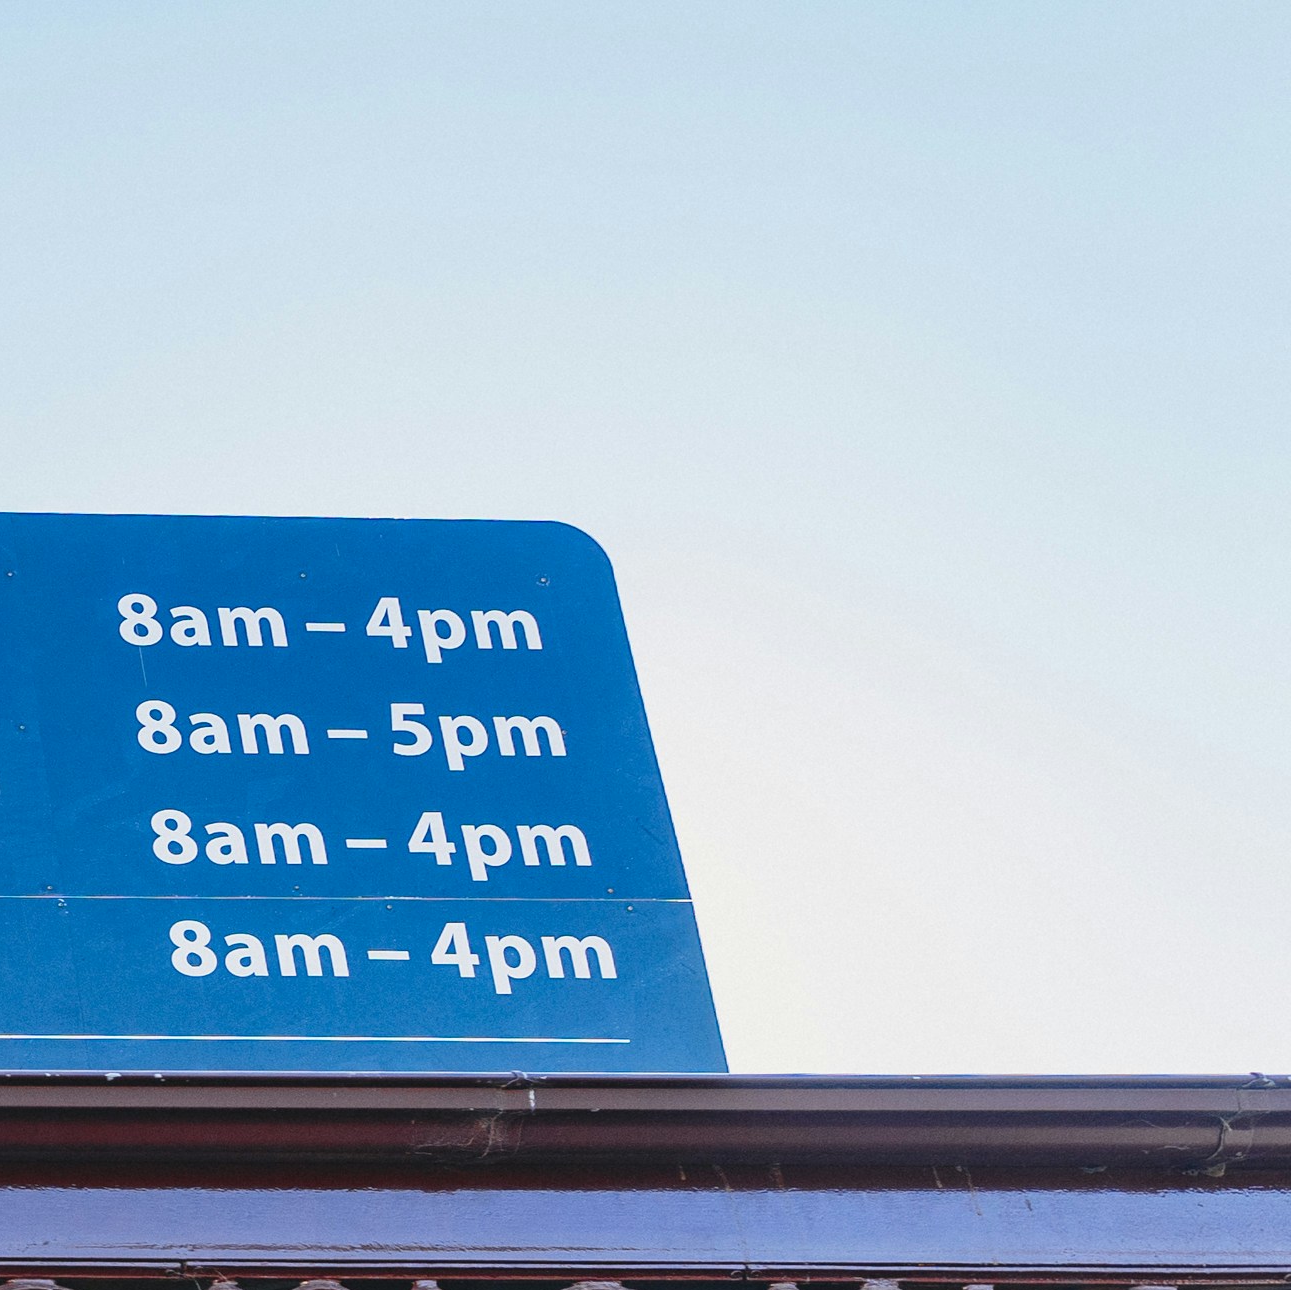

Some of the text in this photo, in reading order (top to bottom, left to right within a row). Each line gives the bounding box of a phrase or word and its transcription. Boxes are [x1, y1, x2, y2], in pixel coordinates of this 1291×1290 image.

[117, 593, 289, 648] 8am
[366, 597, 544, 664] 4pm
[135, 700, 311, 756] 8am
[390, 703, 568, 772] 5pm
[150, 809, 329, 866] 8am
[407, 811, 593, 883] 4pm
[169, 920, 351, 978] 8am
[430, 922, 619, 996] 4pm
